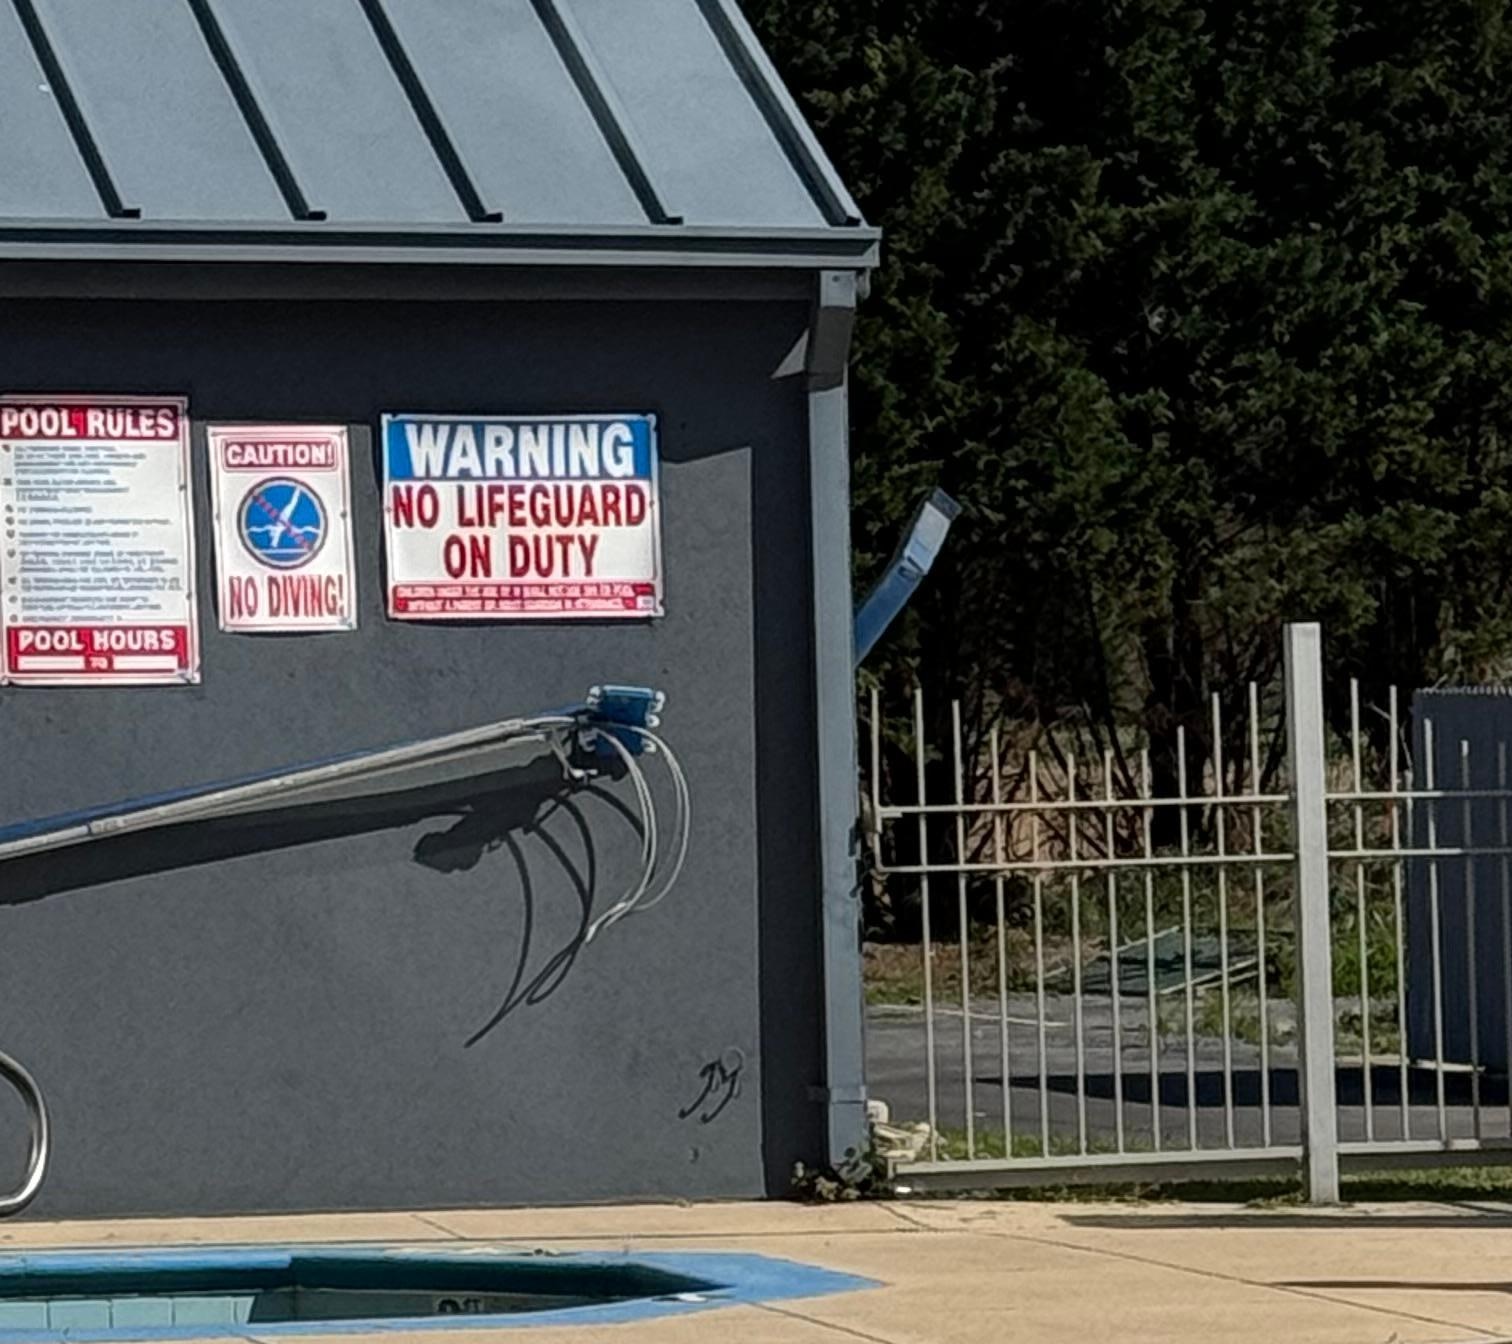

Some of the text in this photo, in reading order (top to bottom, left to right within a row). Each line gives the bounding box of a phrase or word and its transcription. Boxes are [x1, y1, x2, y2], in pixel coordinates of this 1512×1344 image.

[1, 408, 175, 437] POOL RULES
[226, 441, 335, 466] CAUTION!
[404, 422, 635, 478] WARNING
[391, 483, 646, 528] NO LIFEGUARD
[443, 534, 599, 579] ON DUTY
[229, 574, 345, 618] NO DIVING!
[19, 629, 176, 652] POOL HOURS
